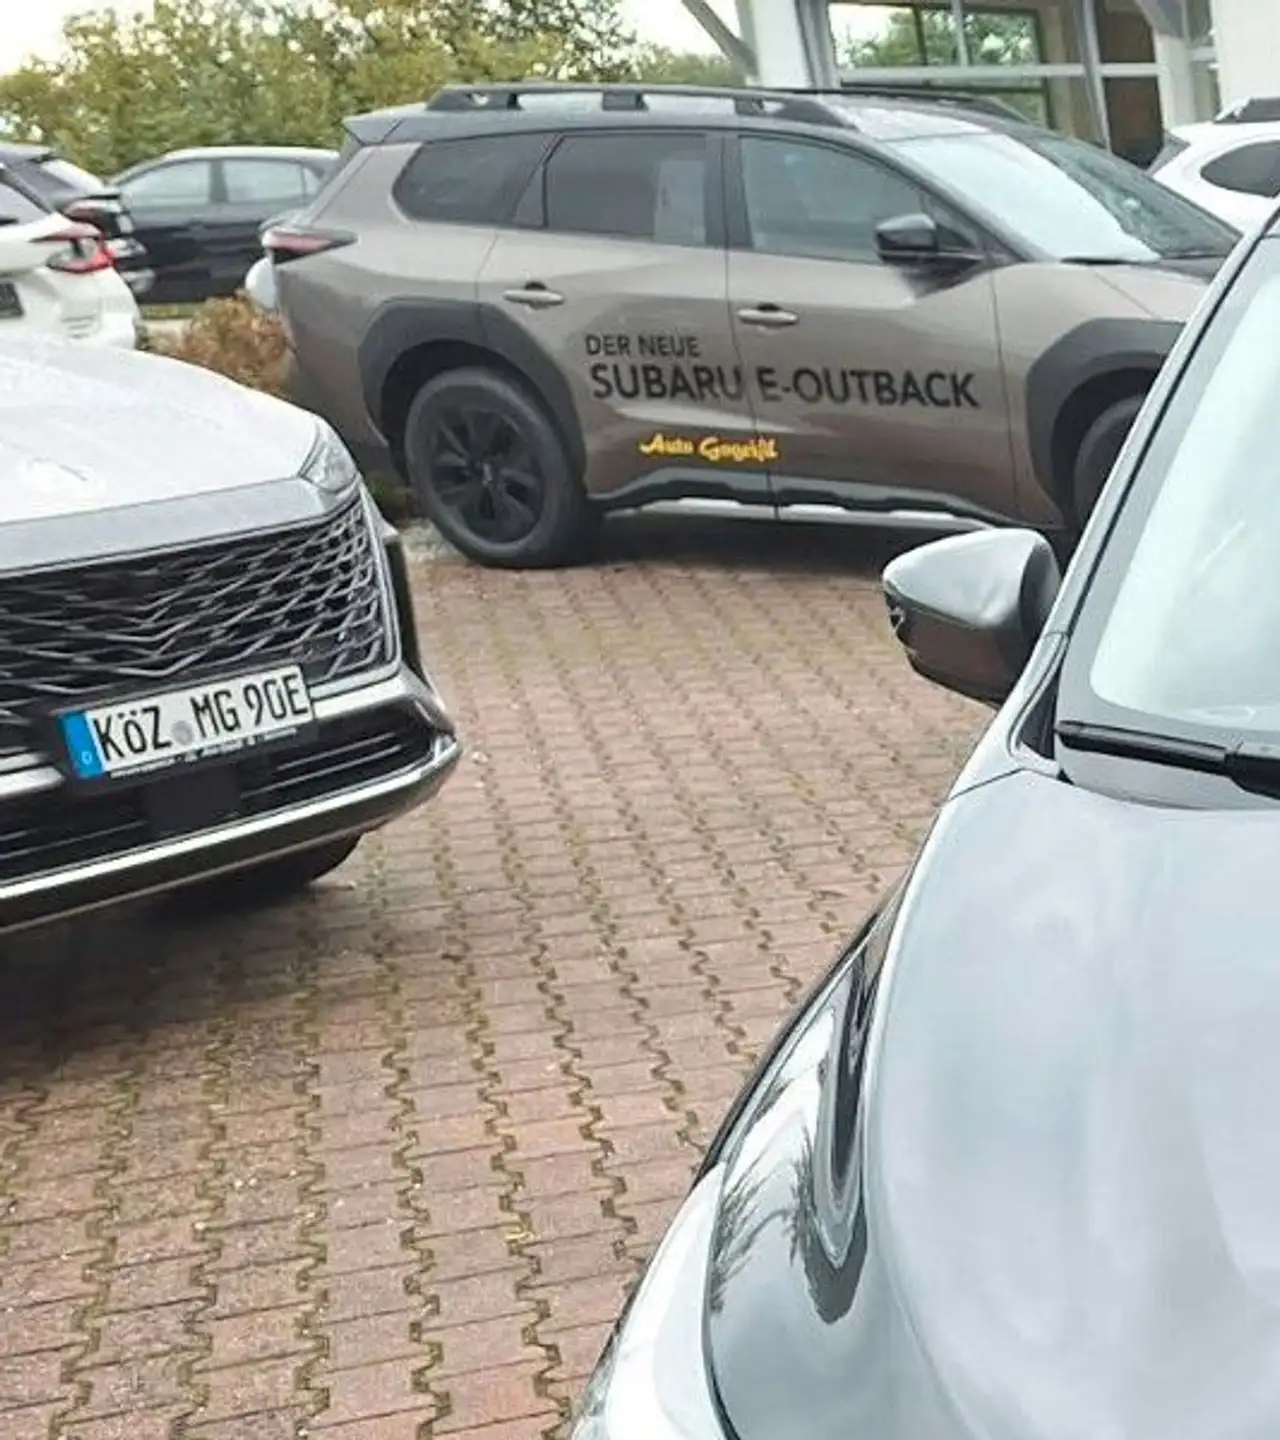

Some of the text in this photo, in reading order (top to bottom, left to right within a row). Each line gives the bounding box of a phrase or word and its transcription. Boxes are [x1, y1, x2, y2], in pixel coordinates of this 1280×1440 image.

[585, 334, 700, 358] DER NEUE
[591, 362, 981, 409] SUBARU E-OUTBACK
[639, 433, 695, 455] Auto
[93, 705, 171, 761] KÖZ
[189, 690, 241, 739] MG
[243, 673, 309, 726] 90E
